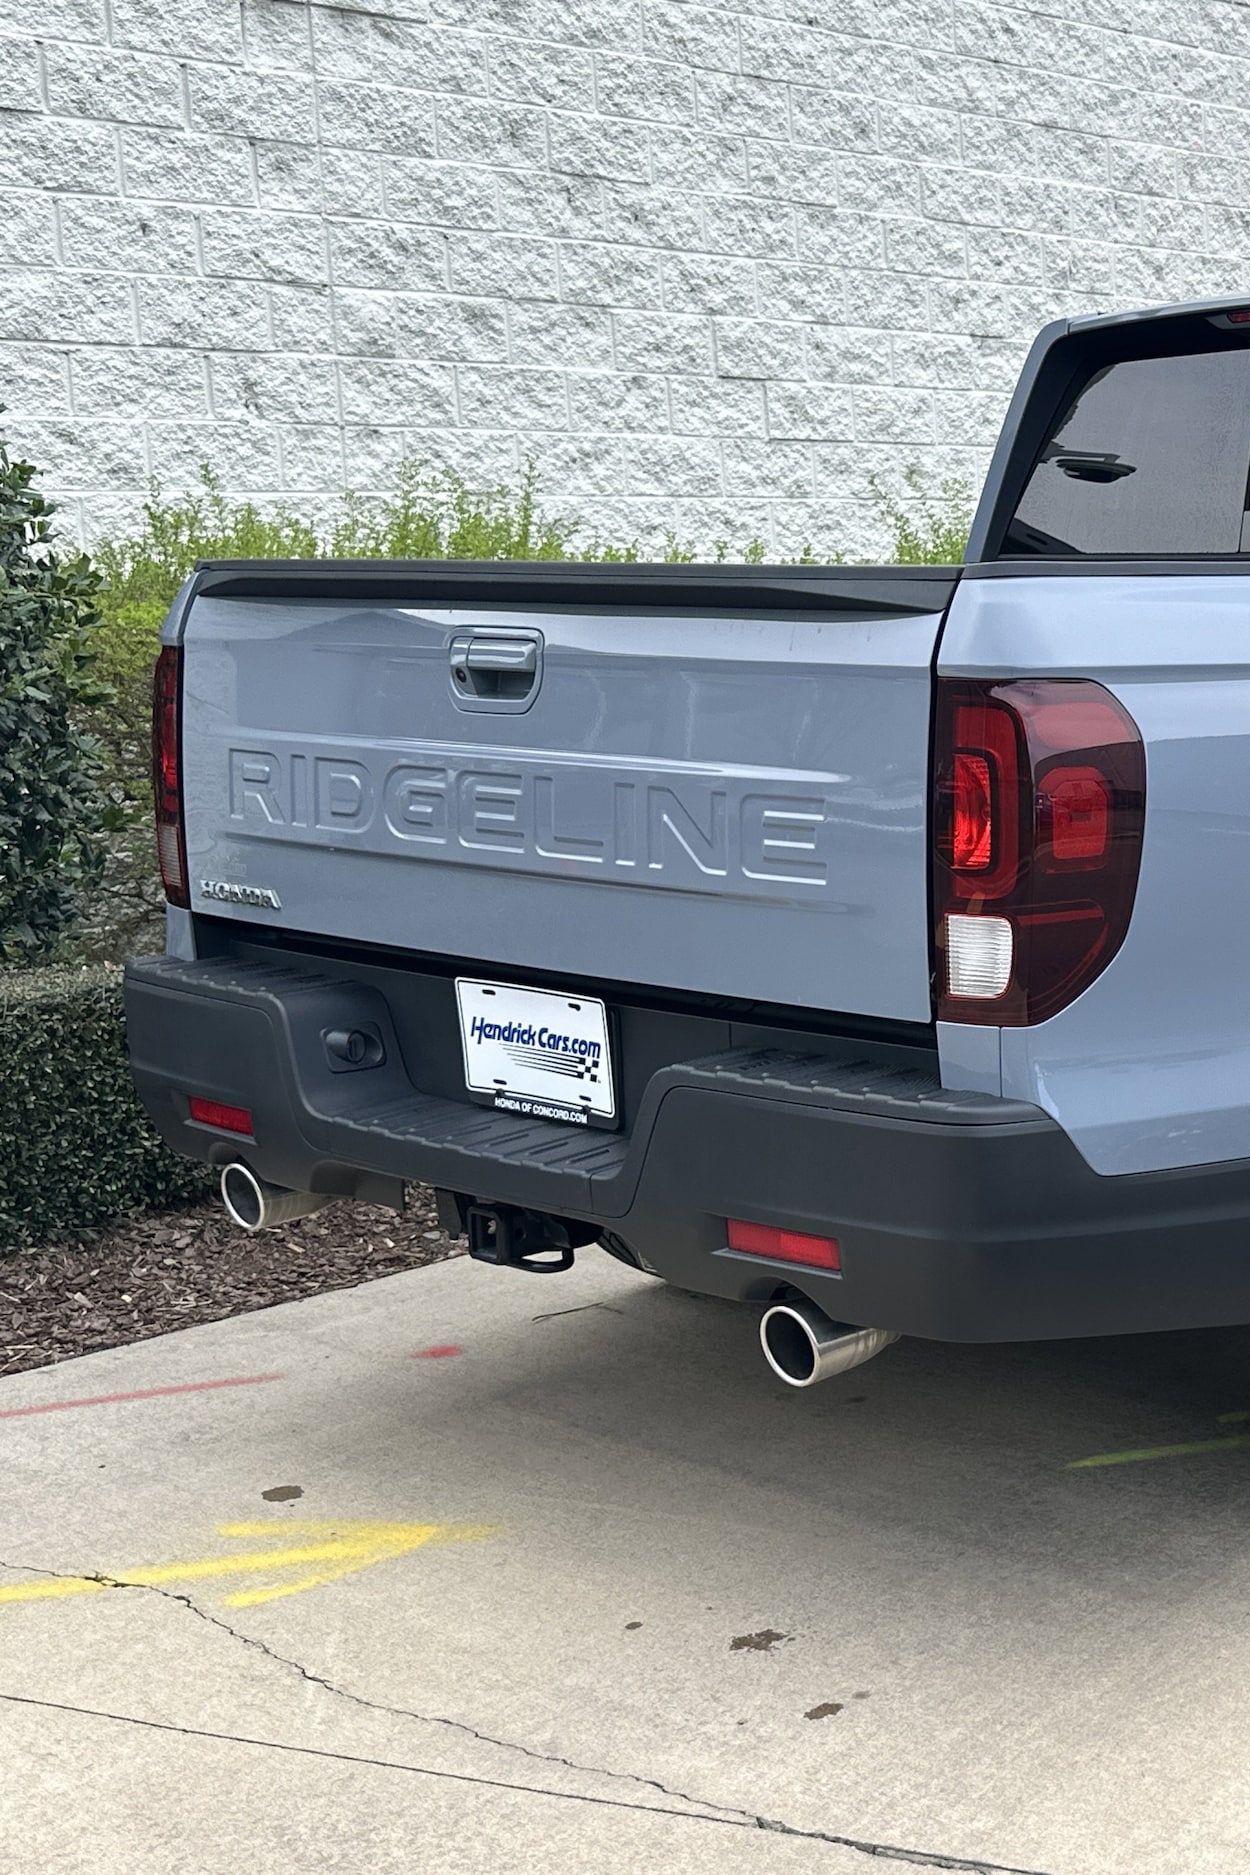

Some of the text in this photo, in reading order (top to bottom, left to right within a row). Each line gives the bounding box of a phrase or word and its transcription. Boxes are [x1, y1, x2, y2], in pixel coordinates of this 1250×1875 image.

[228, 747, 829, 886] RIDGELINE
[200, 879, 282, 910] HONDA
[494, 1097, 588, 1124] HONDA OF CONCORD.COM
